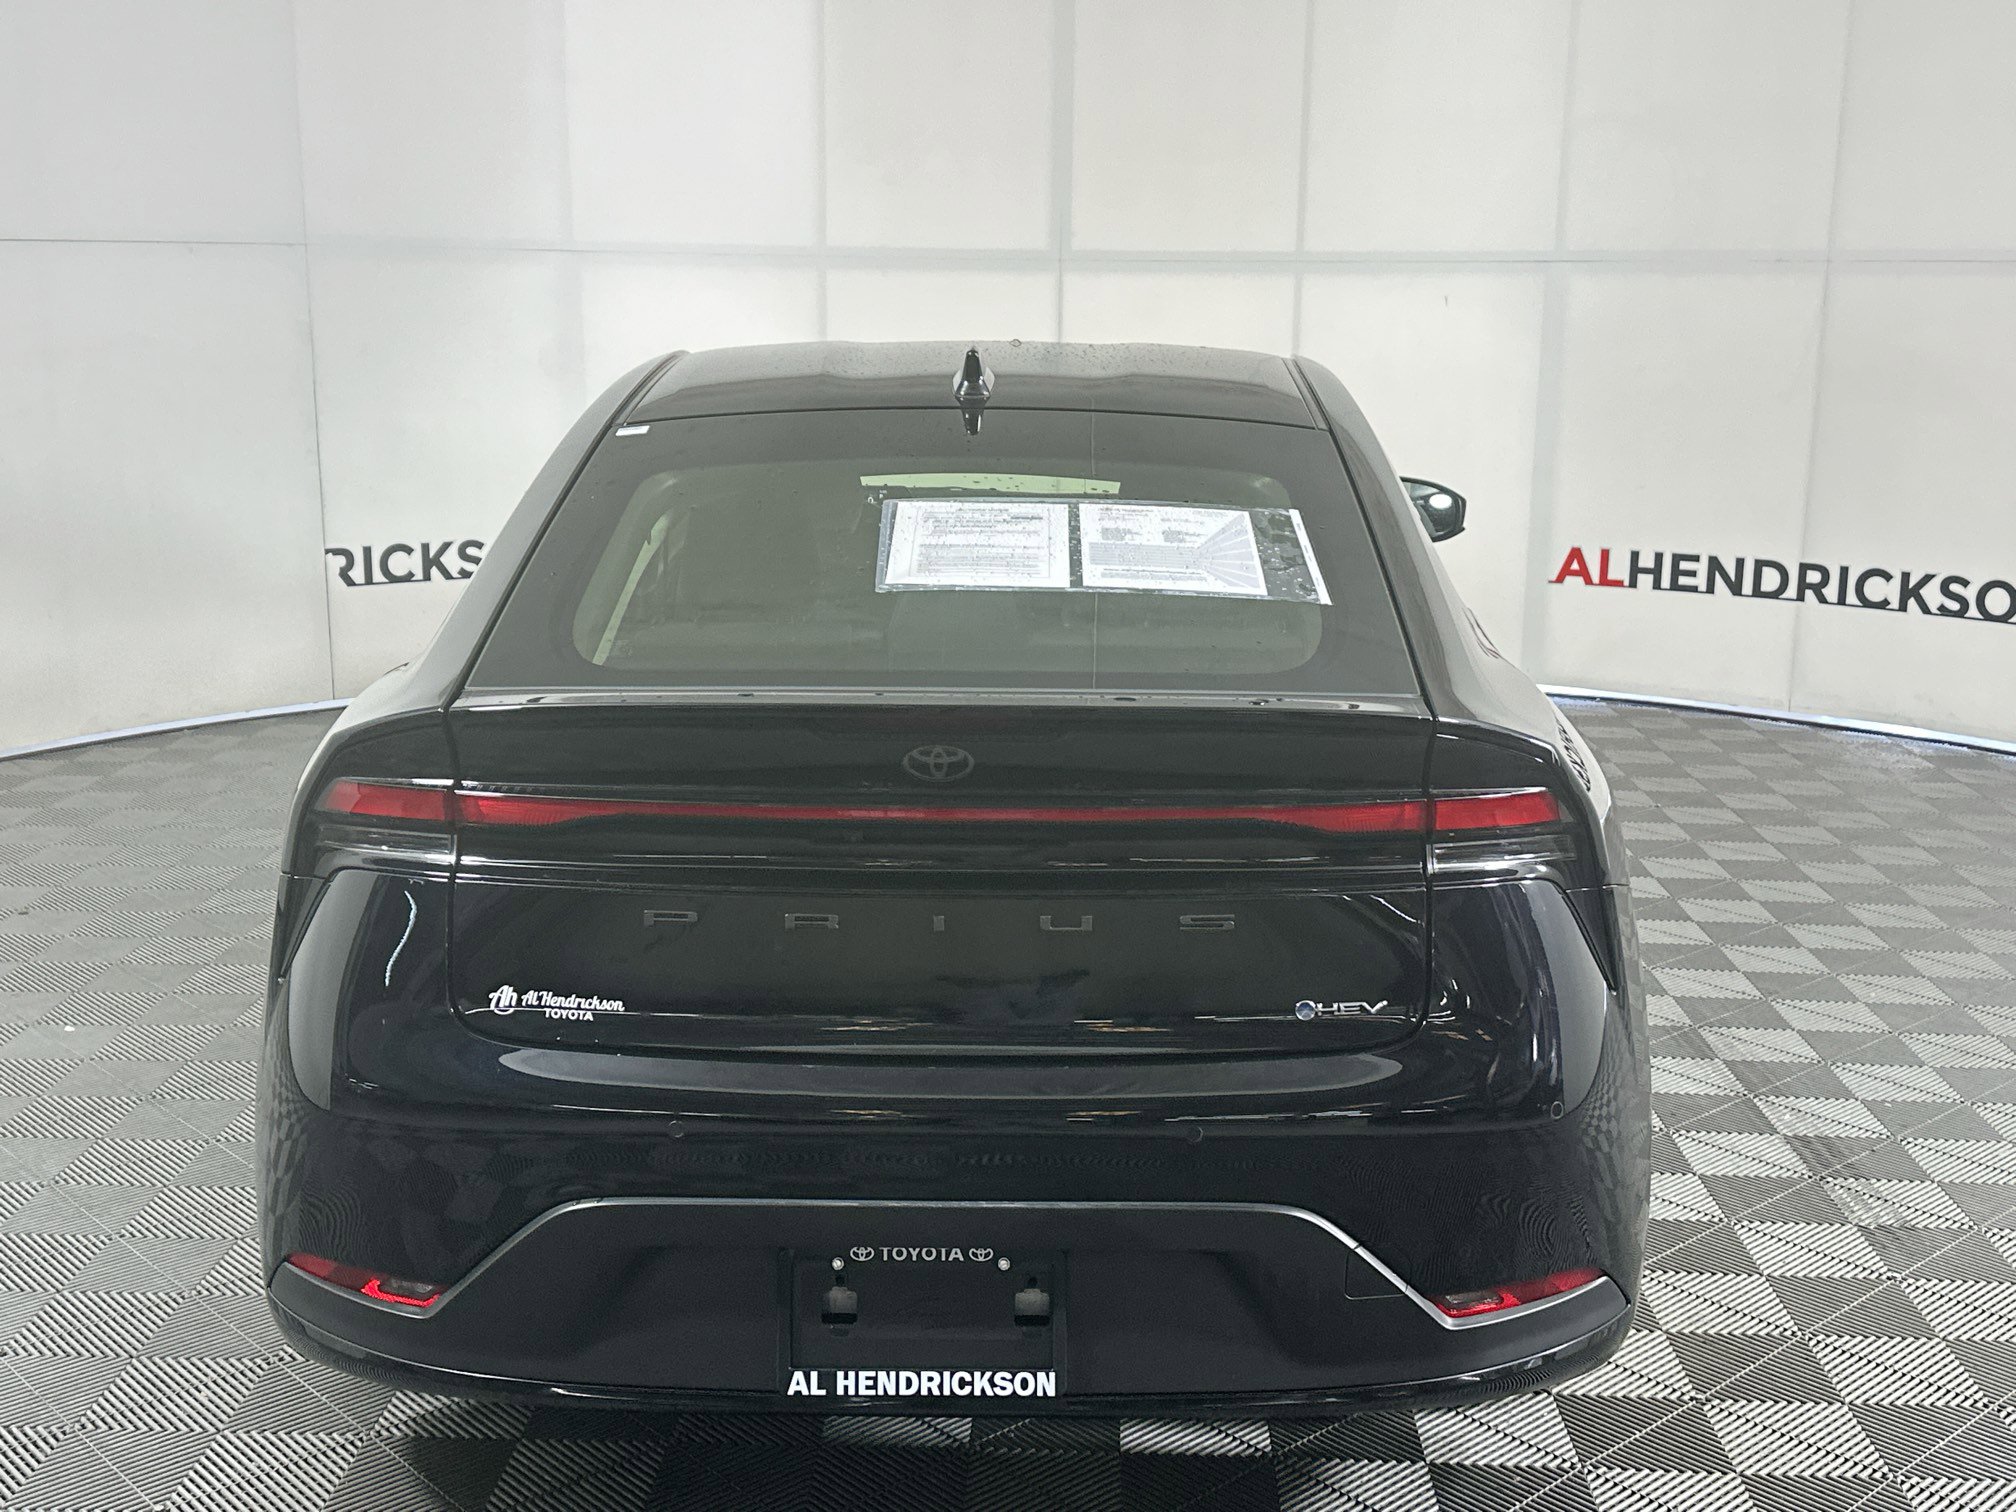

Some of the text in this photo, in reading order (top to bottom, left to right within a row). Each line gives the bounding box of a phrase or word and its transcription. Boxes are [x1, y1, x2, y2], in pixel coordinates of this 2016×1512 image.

[643, 909, 1236, 932] PRIUS
[539, 991, 625, 1011] Hendrickson
[543, 1008, 594, 1021] TOYOTA
[879, 1246, 965, 1262] TOYOTA
[787, 1371, 1056, 1397] AL HENDRICKSON
